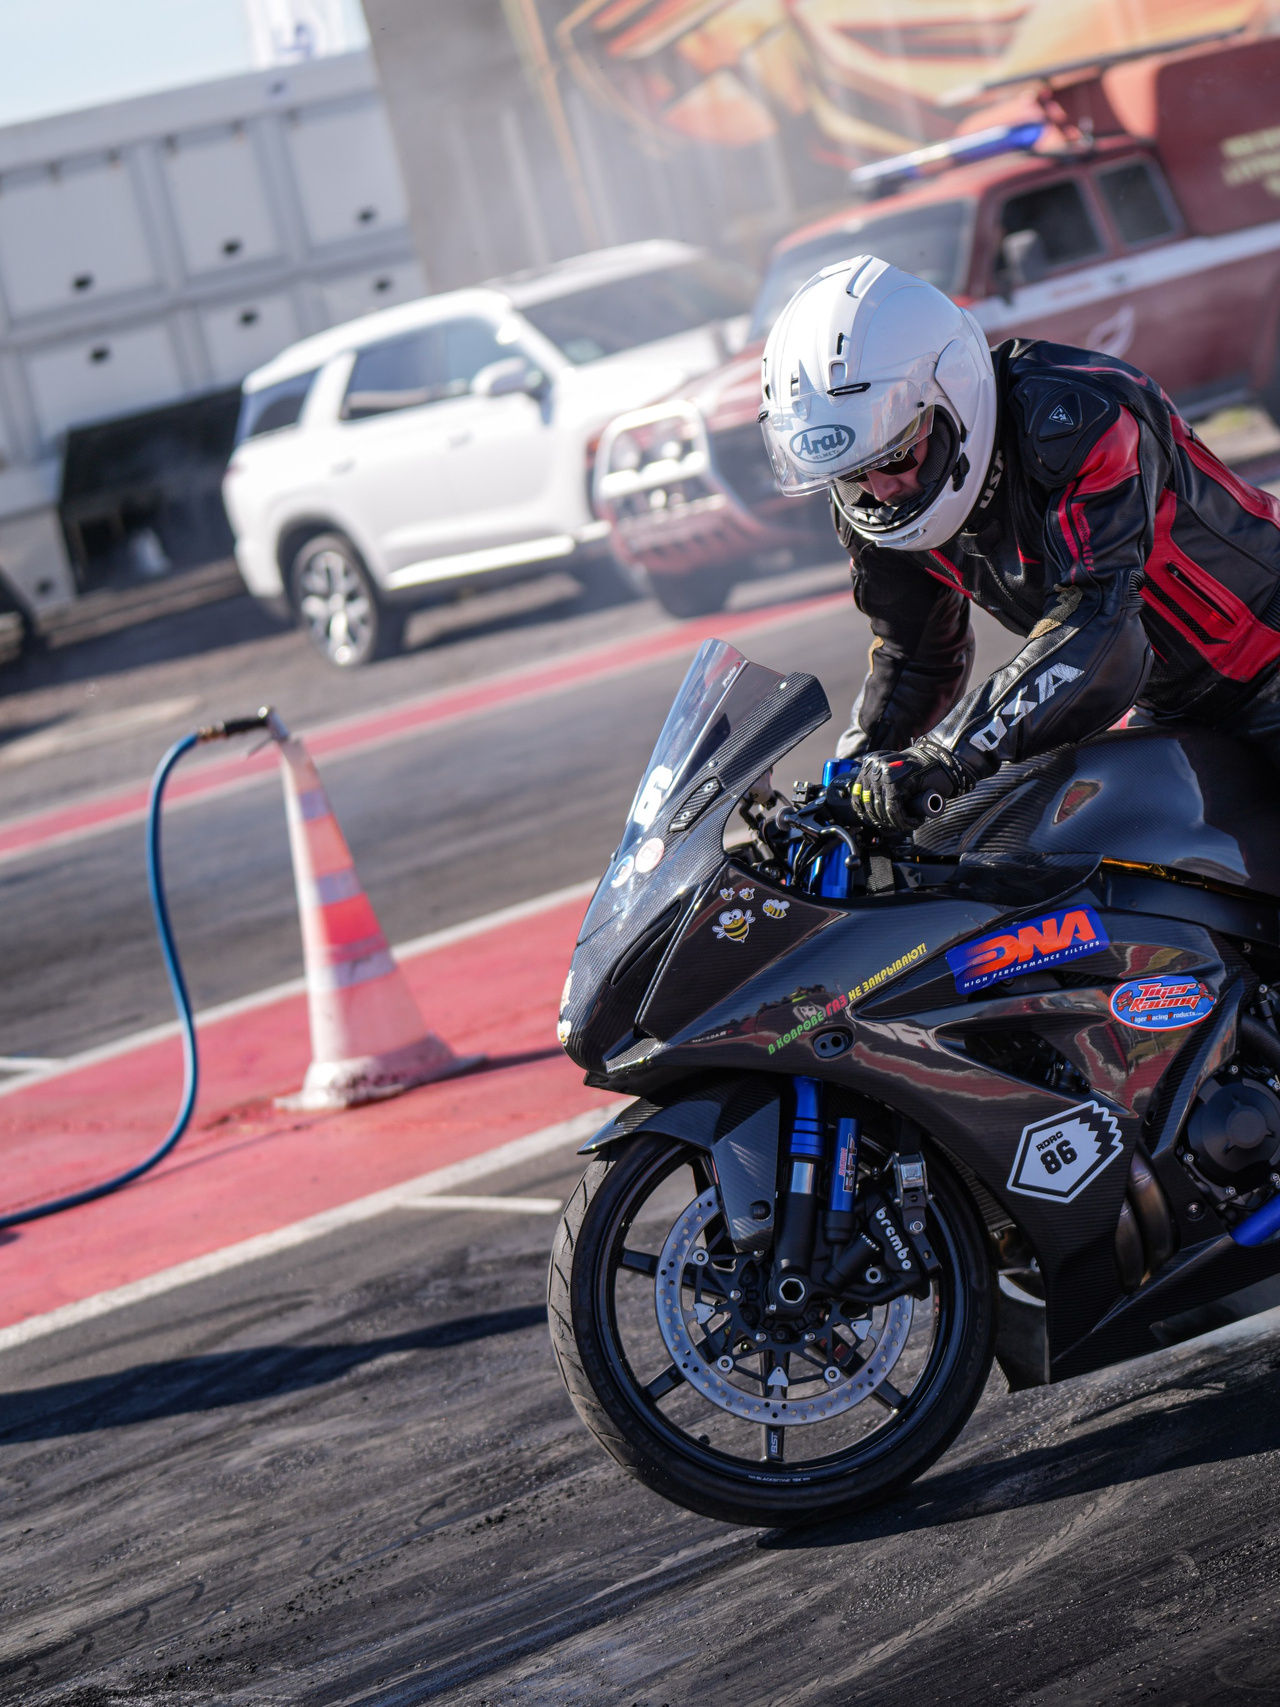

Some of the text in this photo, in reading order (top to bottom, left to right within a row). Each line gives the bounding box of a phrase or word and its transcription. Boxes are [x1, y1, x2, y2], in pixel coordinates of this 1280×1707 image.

[798, 425, 847, 456] Arai
[965, 910, 1097, 979] DNA
[964, 940, 1100, 988] HIGH PERFORMANCE FILTERS
[767, 942, 927, 1055] В КОВРОВЕ ГАЗ НЕ ЗАКРЫВАЮТ!
[1129, 995, 1201, 1012] Racing
[1138, 983, 1197, 999] Tiger
[1036, 1131, 1064, 1152] RDRC
[1040, 1140, 1078, 1175] 86
[876, 1207, 912, 1270] brembo
[770, 1431, 778, 1454] BST
